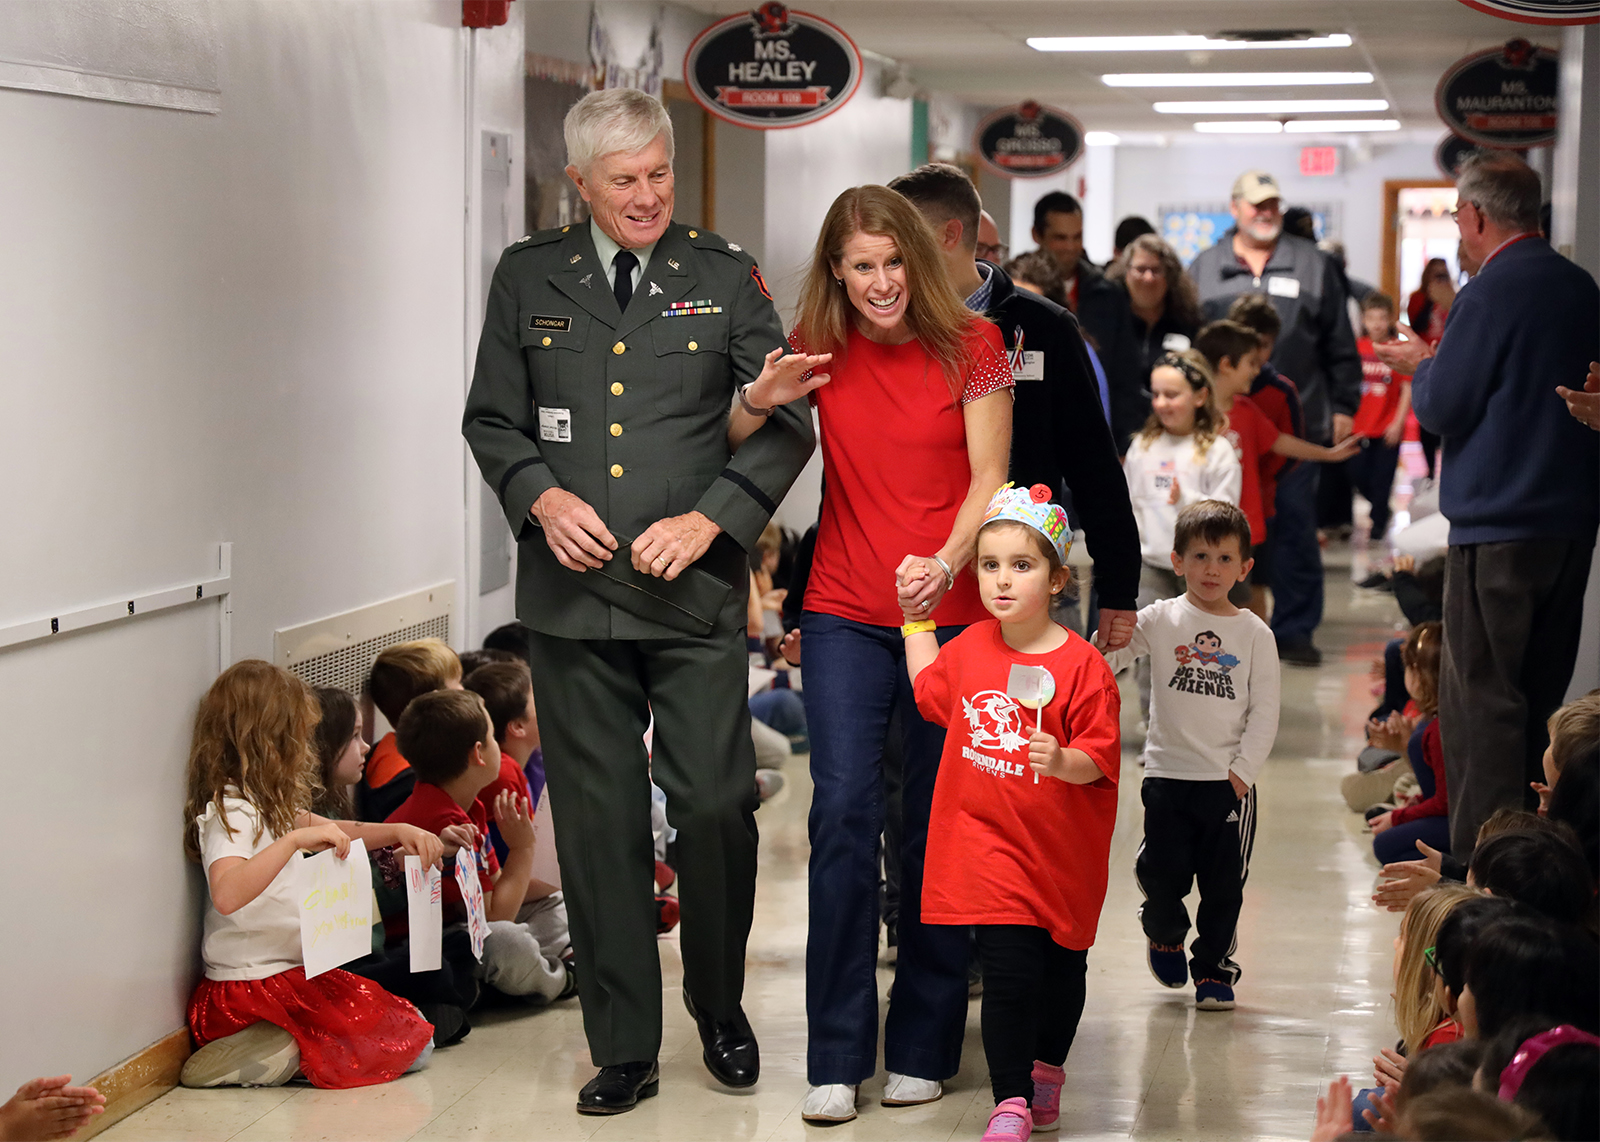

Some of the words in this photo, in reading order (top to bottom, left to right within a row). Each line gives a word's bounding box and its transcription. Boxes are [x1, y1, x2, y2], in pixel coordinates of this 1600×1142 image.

[754, 40, 796, 60] MS.
[728, 60, 817, 82] HEALEY
[742, 91, 779, 103] ROOM
[534, 318, 565, 328] SCHONGAR
[1034, 489, 1048, 499] 5
[1196, 667, 1233, 686] SUPER
[1168, 675, 1236, 701] FRIENDS
[961, 745, 1025, 777] ROSENDALE
